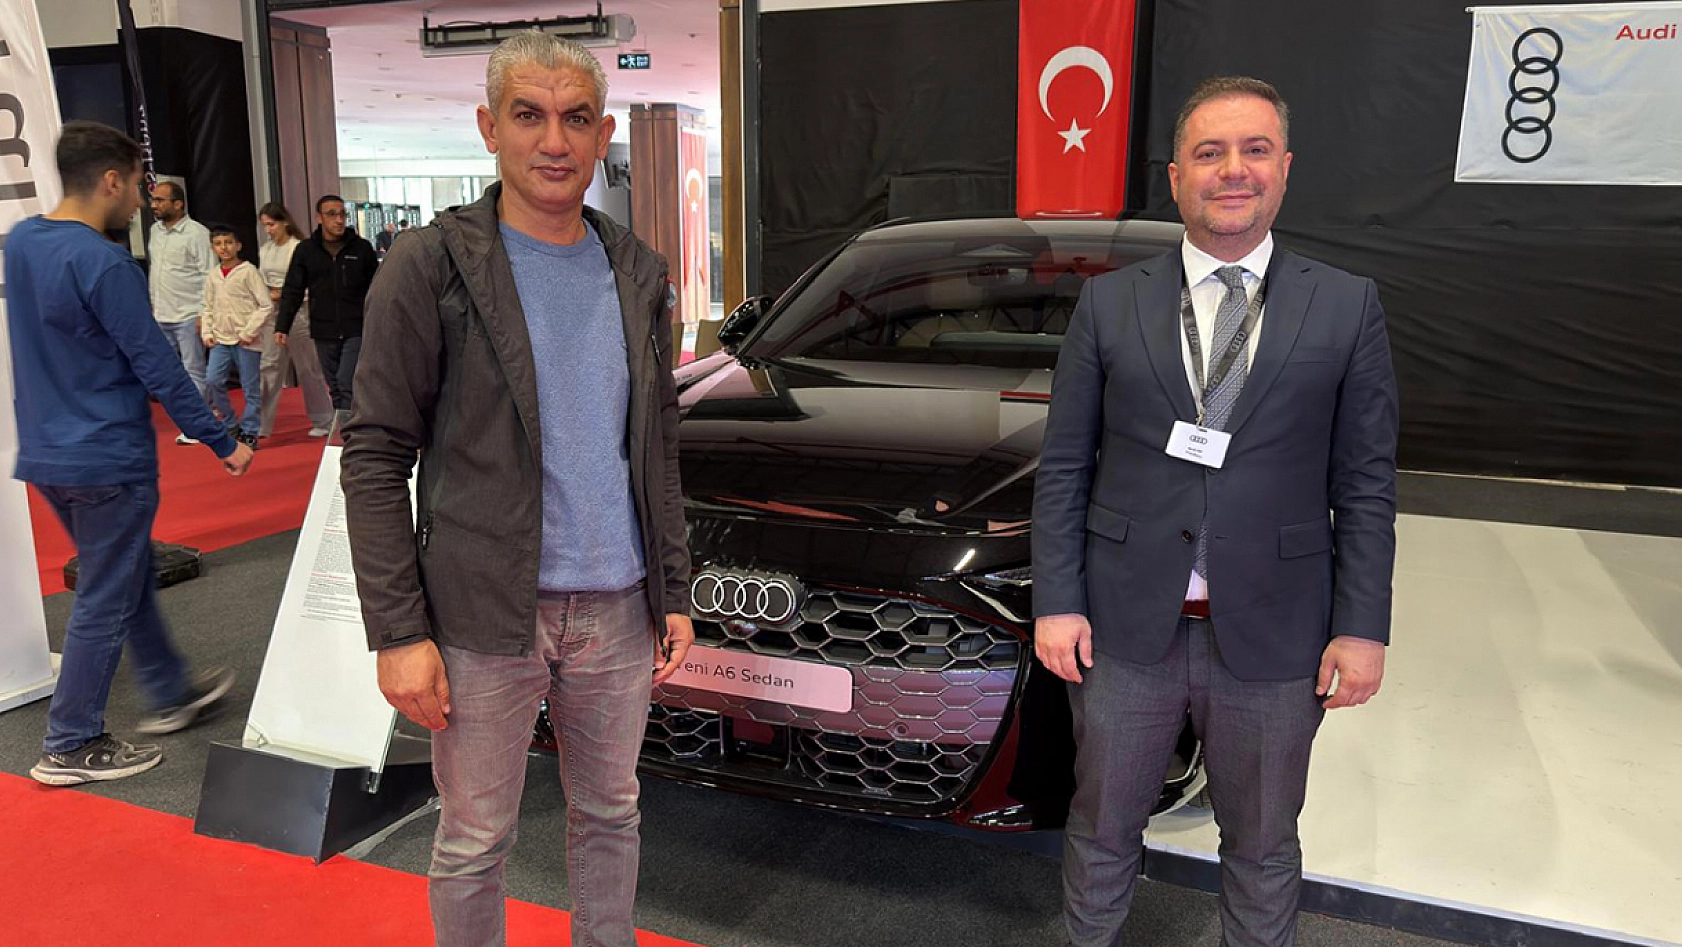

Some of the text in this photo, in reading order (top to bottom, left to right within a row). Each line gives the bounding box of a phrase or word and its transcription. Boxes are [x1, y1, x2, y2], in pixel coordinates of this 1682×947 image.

[1615, 23, 1677, 41] Audi
[678, 661, 794, 689] eni A6 Sedan
